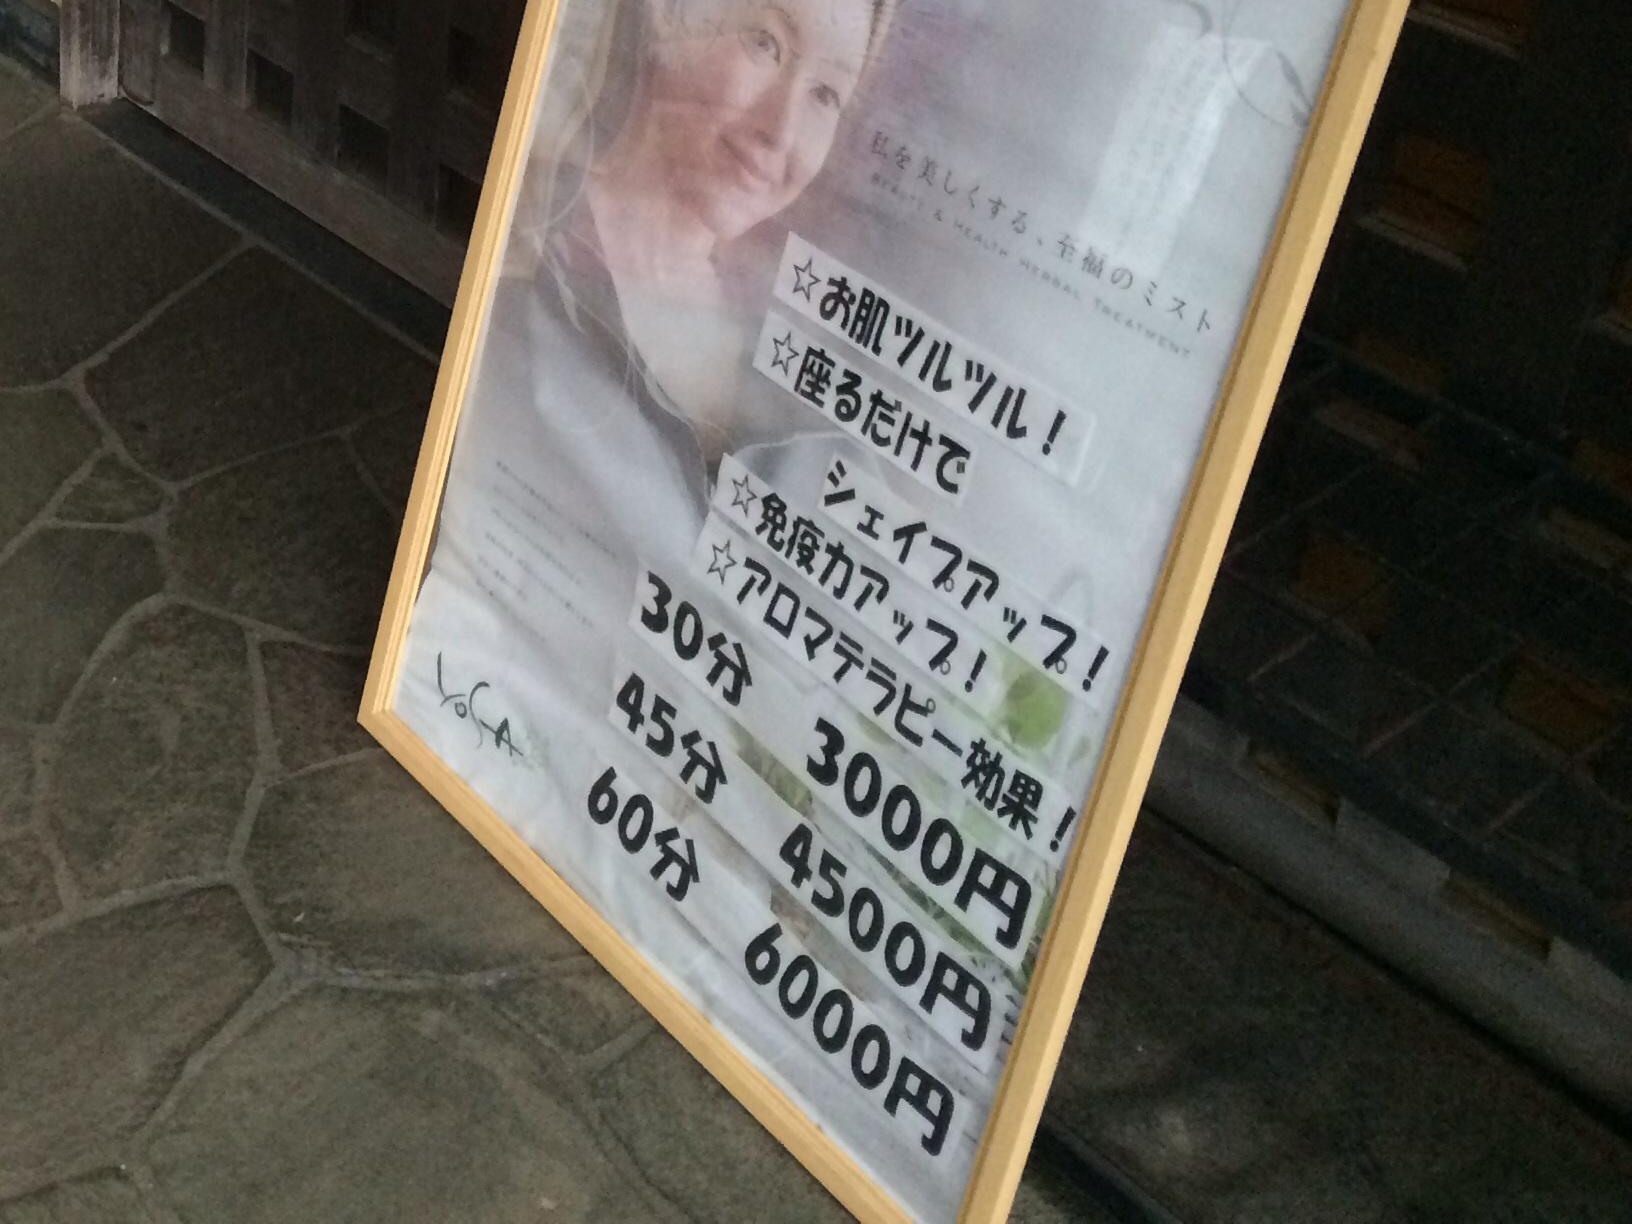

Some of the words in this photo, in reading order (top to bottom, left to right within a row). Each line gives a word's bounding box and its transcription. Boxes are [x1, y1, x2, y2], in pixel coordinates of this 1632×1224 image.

[798, 346, 972, 495] 座るだけで
[825, 460, 1111, 693] シェイプアップ！
[615, 674, 728, 805] 45分
[779, 823, 992, 1051] 4500円
[640, 571, 753, 706] 30分
[806, 718, 1032, 950] 3000円
[587, 767, 701, 903] 60分
[744, 923, 956, 1156] 6000円
